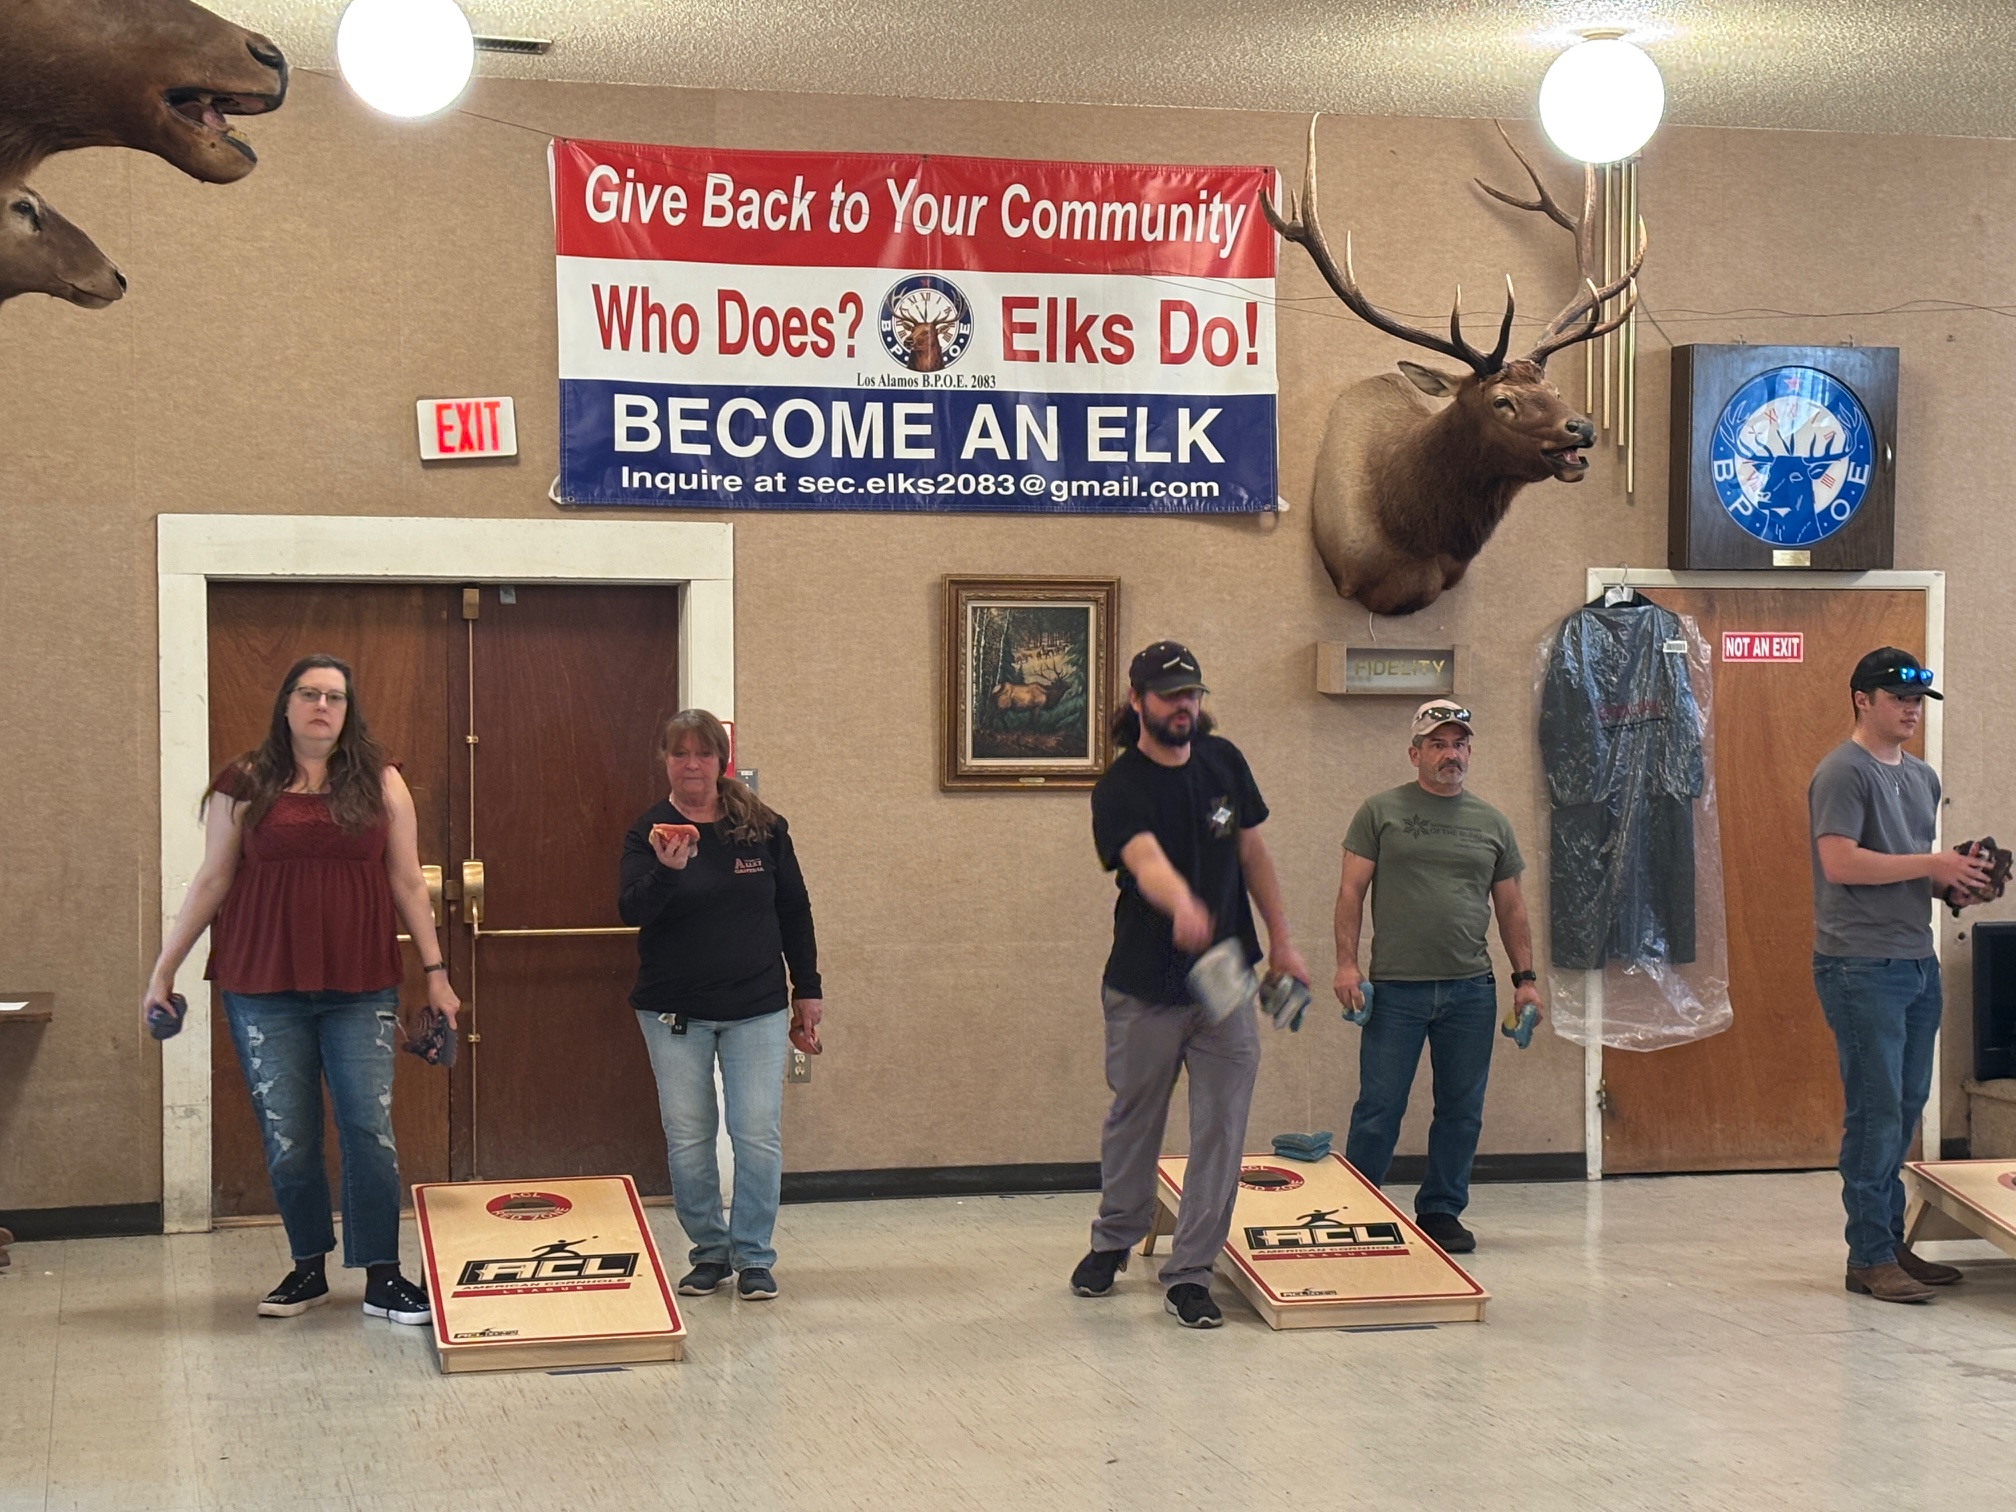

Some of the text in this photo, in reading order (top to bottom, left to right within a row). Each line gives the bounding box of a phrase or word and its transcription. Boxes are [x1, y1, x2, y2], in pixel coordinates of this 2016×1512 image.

[585, 164, 1247, 259] Give Back to Your Community
[591, 283, 864, 359] Who Does?
[1001, 296, 1259, 368] Elks Do!
[857, 372, 996, 389] Los Alamos B.P.O.E. 2083
[435, 401, 501, 453] EXIT
[613, 393, 1226, 463] BECOME AN ELK
[621, 466, 1220, 502] Inquire at sec.elks2083@gmail.com
[1725, 636, 1800, 657] NOT AN EXIT
[1355, 659, 1446, 677] FIDELITY
[1255, 1225, 1396, 1246] ACL
[473, 1257, 626, 1282] ACL
[461, 1278, 627, 1290] AMERICAN CORNHOLE
[502, 1286, 585, 1294] LEAGUE
